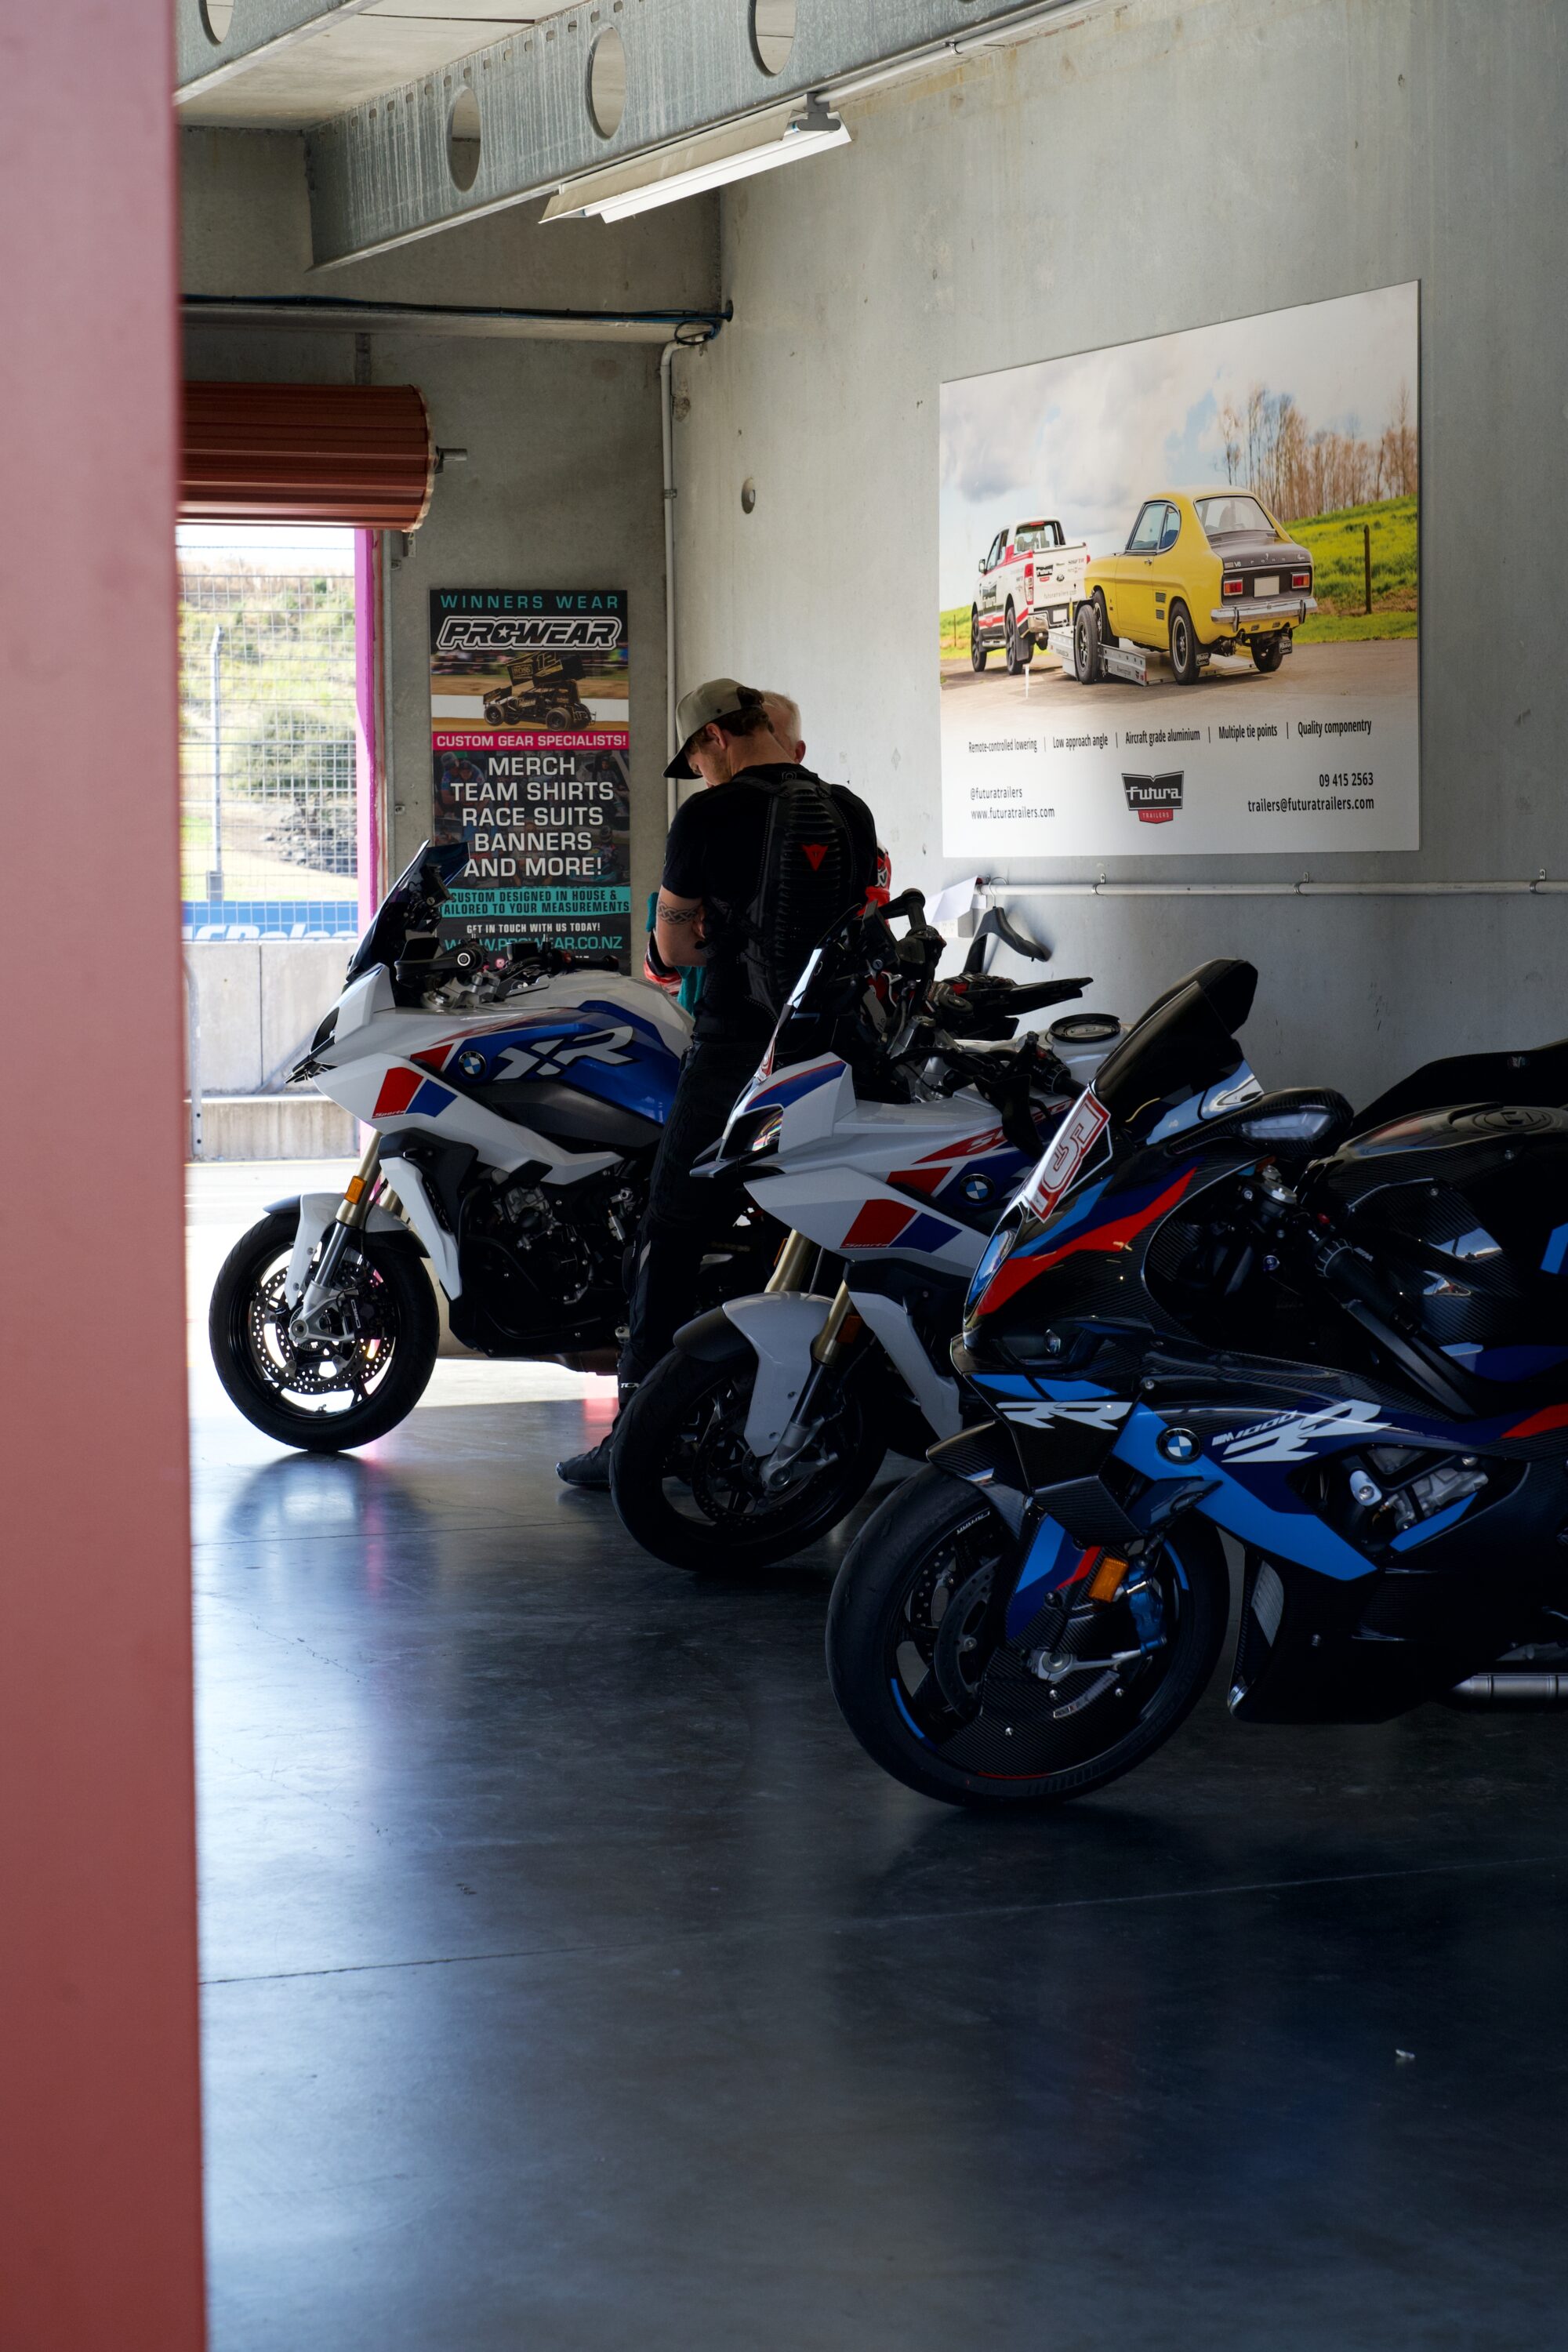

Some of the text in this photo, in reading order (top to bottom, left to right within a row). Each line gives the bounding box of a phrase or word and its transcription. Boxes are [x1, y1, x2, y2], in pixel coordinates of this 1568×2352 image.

[440, 594, 619, 609] WINNERS WEAR
[1125, 728, 1200, 746] Aircraft grade aluminium
[1218, 723, 1278, 742] Multiple tie points
[1298, 718, 1372, 738] Quality componentry
[436, 734, 626, 747] CUSTOM GEAR SPECIALISTS!
[968, 737, 1038, 753] Remote-controlled lowering
[1053, 733, 1109, 751] Low approach angle
[488, 757, 575, 776] MERCH
[1319, 772, 1374, 787] 09 415 2563
[451, 781, 614, 801] TEAM SHIRTS
[970, 786, 1023, 800] @futuratrailers
[971, 805, 1055, 820] www.futuratrailers.com
[1247, 796, 1374, 812] trailers@futuratrailers.com
[462, 806, 604, 826] RACE SUITS
[474, 832, 592, 852] BANNERS
[463, 856, 602, 877] AND MORE!
[452, 889, 617, 903] CUSTOM DESIGNED IN HOUSE &
[492, 902, 505, 914] TO
[510, 902, 537, 913] YOUR
[542, 900, 630, 913] MEASUREMENTS
[485, 924, 495, 934] IN
[499, 924, 527, 933] TOUCH
[529, 923, 553, 933] WITH
[556, 923, 568, 932] US
[570, 922, 601, 931] TODAY!
[492, 1025, 633, 1081] XR
[995, 1401, 1134, 1431] RR
[1220, 1399, 1393, 1463] RR
